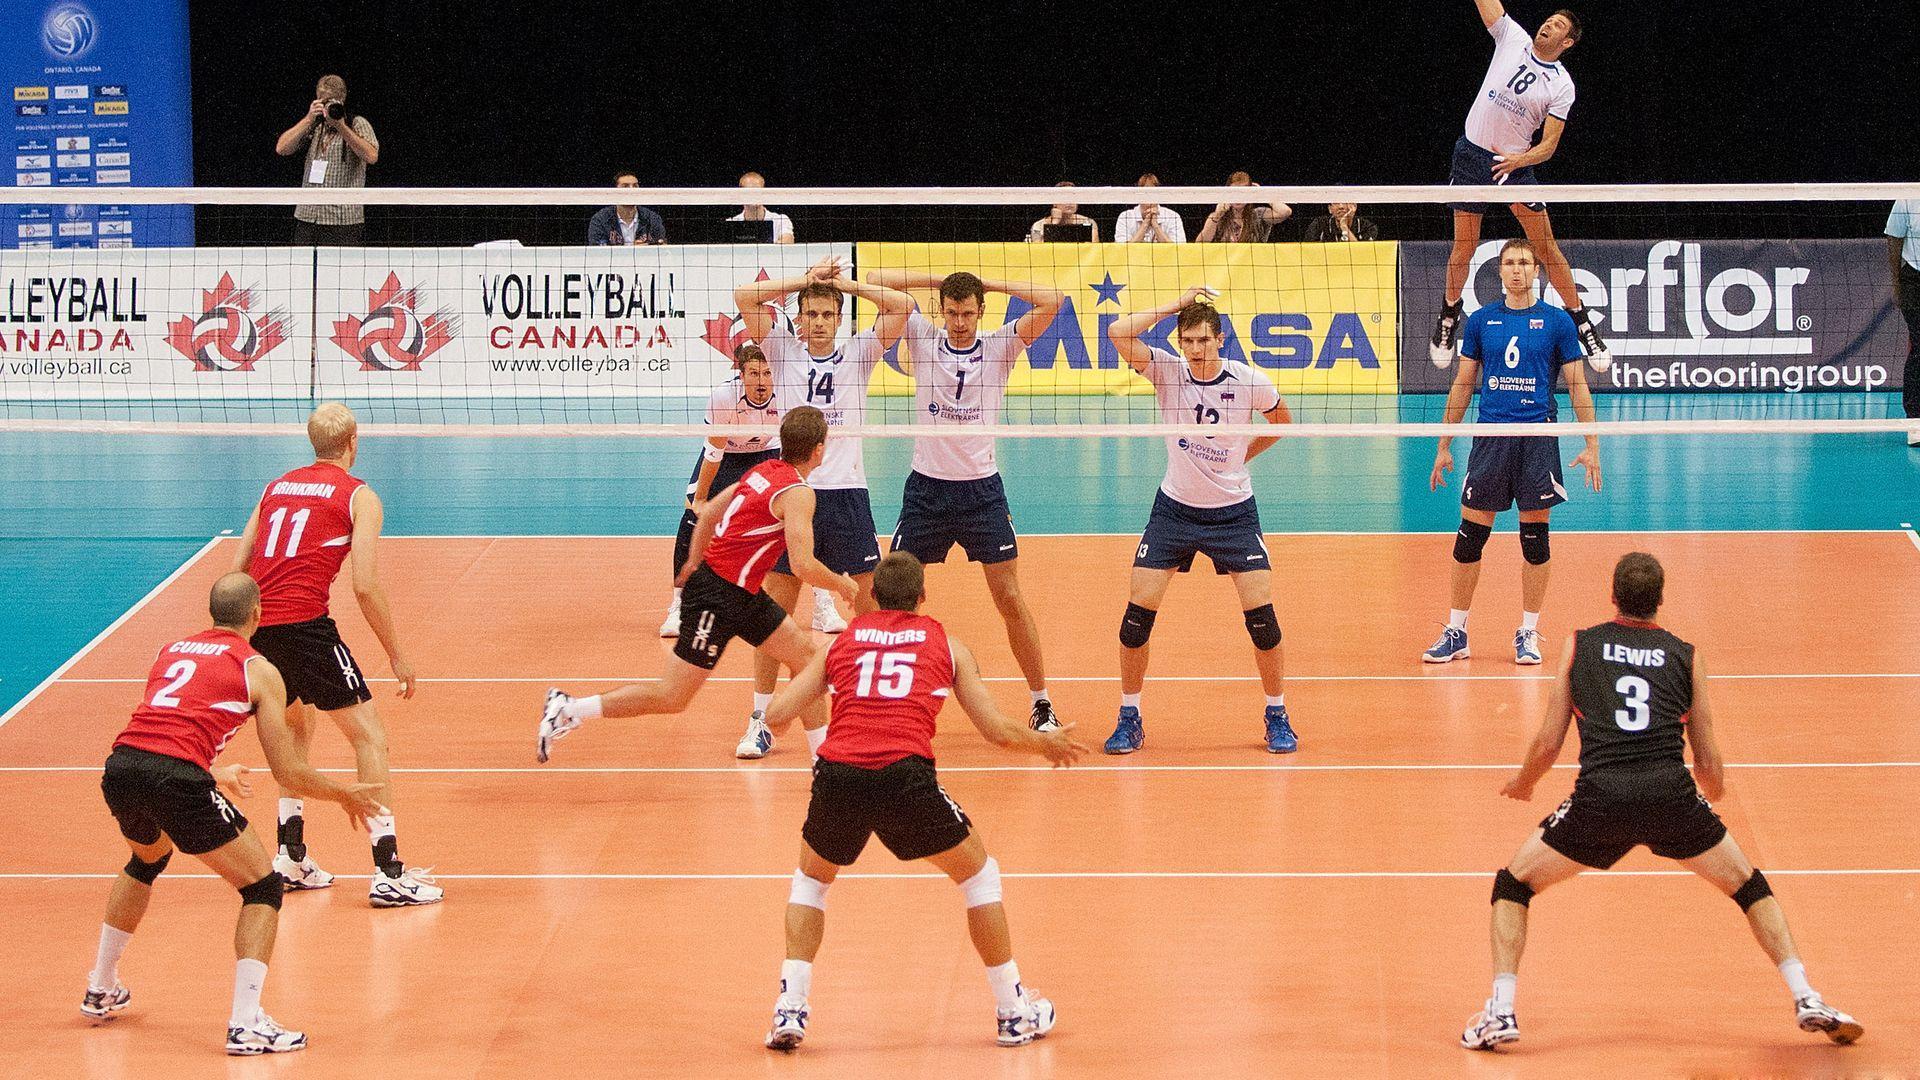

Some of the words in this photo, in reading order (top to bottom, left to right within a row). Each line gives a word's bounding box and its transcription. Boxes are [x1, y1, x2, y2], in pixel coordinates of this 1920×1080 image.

[1506, 64, 1537, 95] 18
[0, 277, 147, 323] LEYBALL
[479, 273, 686, 320] VOLLEYBALL
[490, 325, 673, 349] CANADA
[1504, 336, 1520, 369] 6
[491, 355, 671, 376] www.volleyba.ca
[1611, 361, 1888, 392] theflooringroup
[807, 368, 834, 404] 14
[271, 481, 336, 498] BRINKMAN
[264, 507, 311, 558] 11
[1137, 543, 1149, 558] 13
[169, 641, 231, 656] CUNDY
[854, 629, 927, 645] WINTERS
[1603, 643, 1665, 667] LEWIS
[150, 659, 197, 708] 2
[855, 650, 917, 698] 15
[1615, 675, 1650, 731] 3
